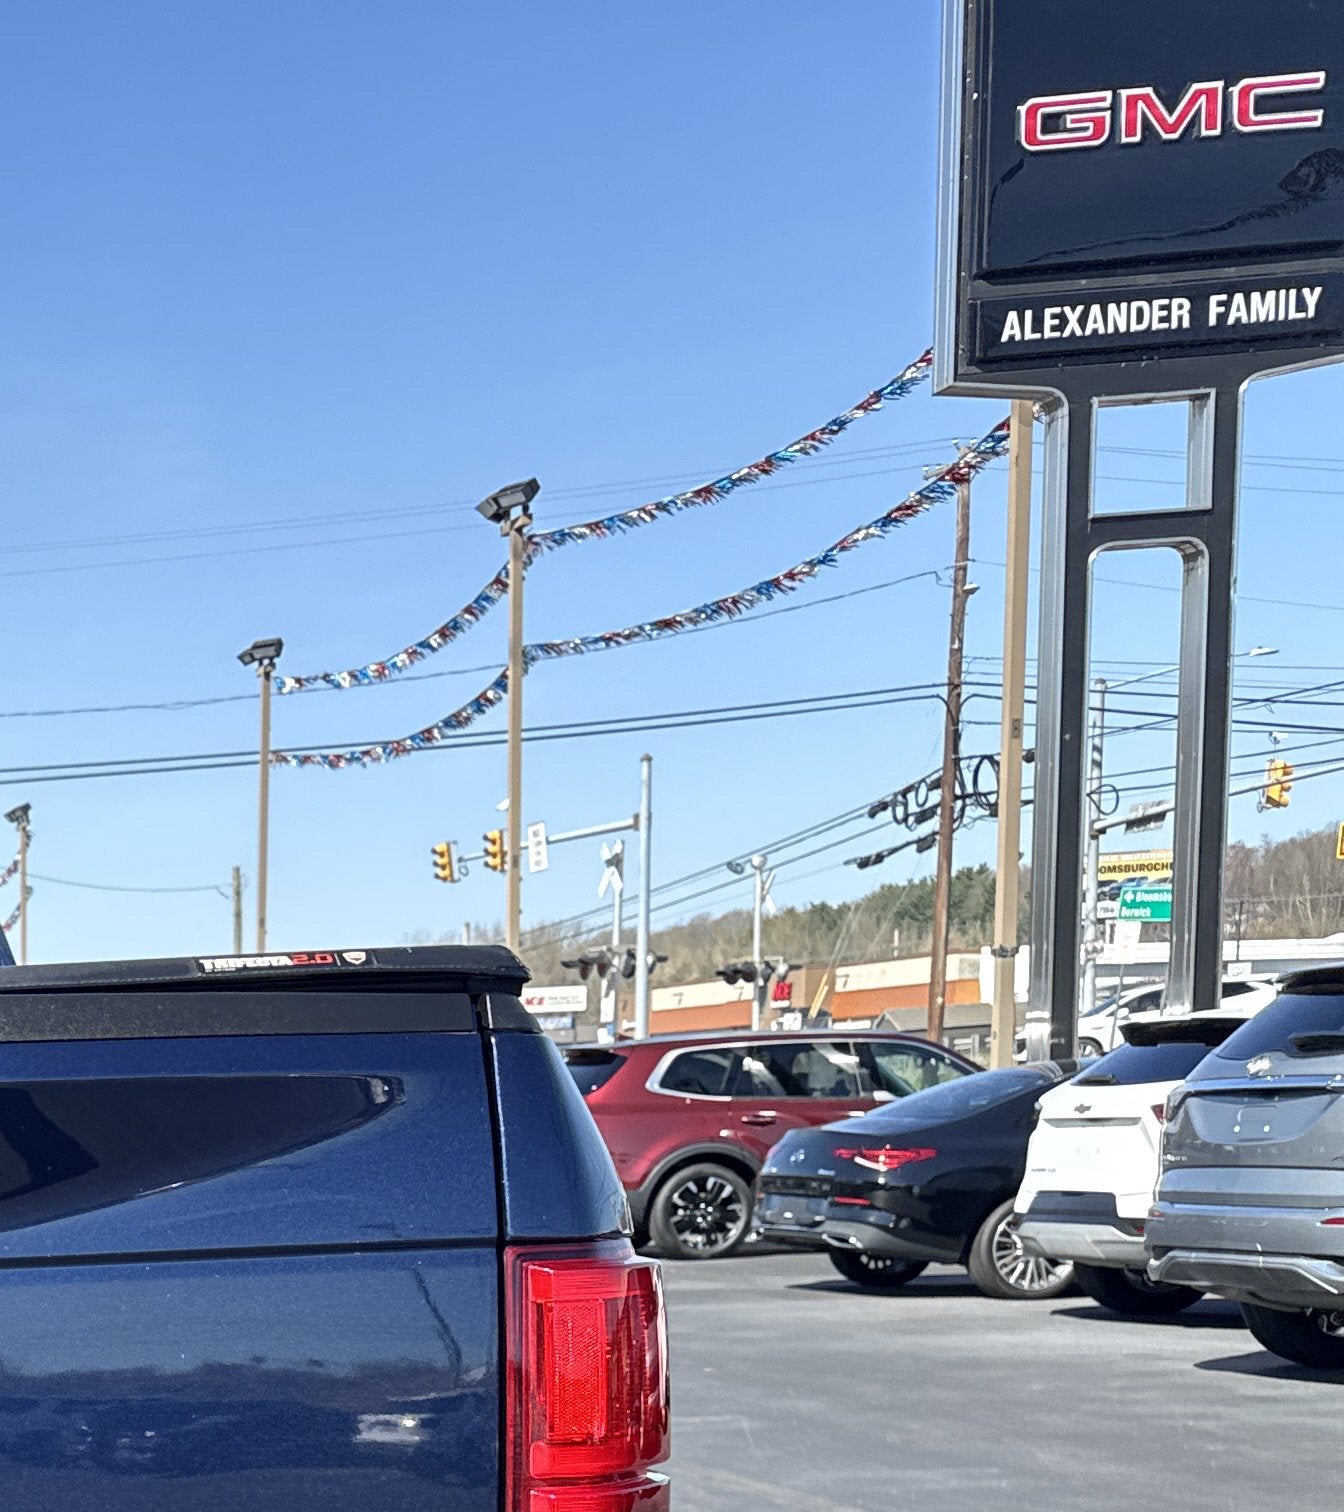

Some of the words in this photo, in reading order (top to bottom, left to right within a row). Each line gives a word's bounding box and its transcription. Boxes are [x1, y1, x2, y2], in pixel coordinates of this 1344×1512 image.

[1016, 71, 1326, 152] GMC
[1000, 296, 1191, 344] ALEXANDER
[1208, 286, 1323, 328] FAMILY
